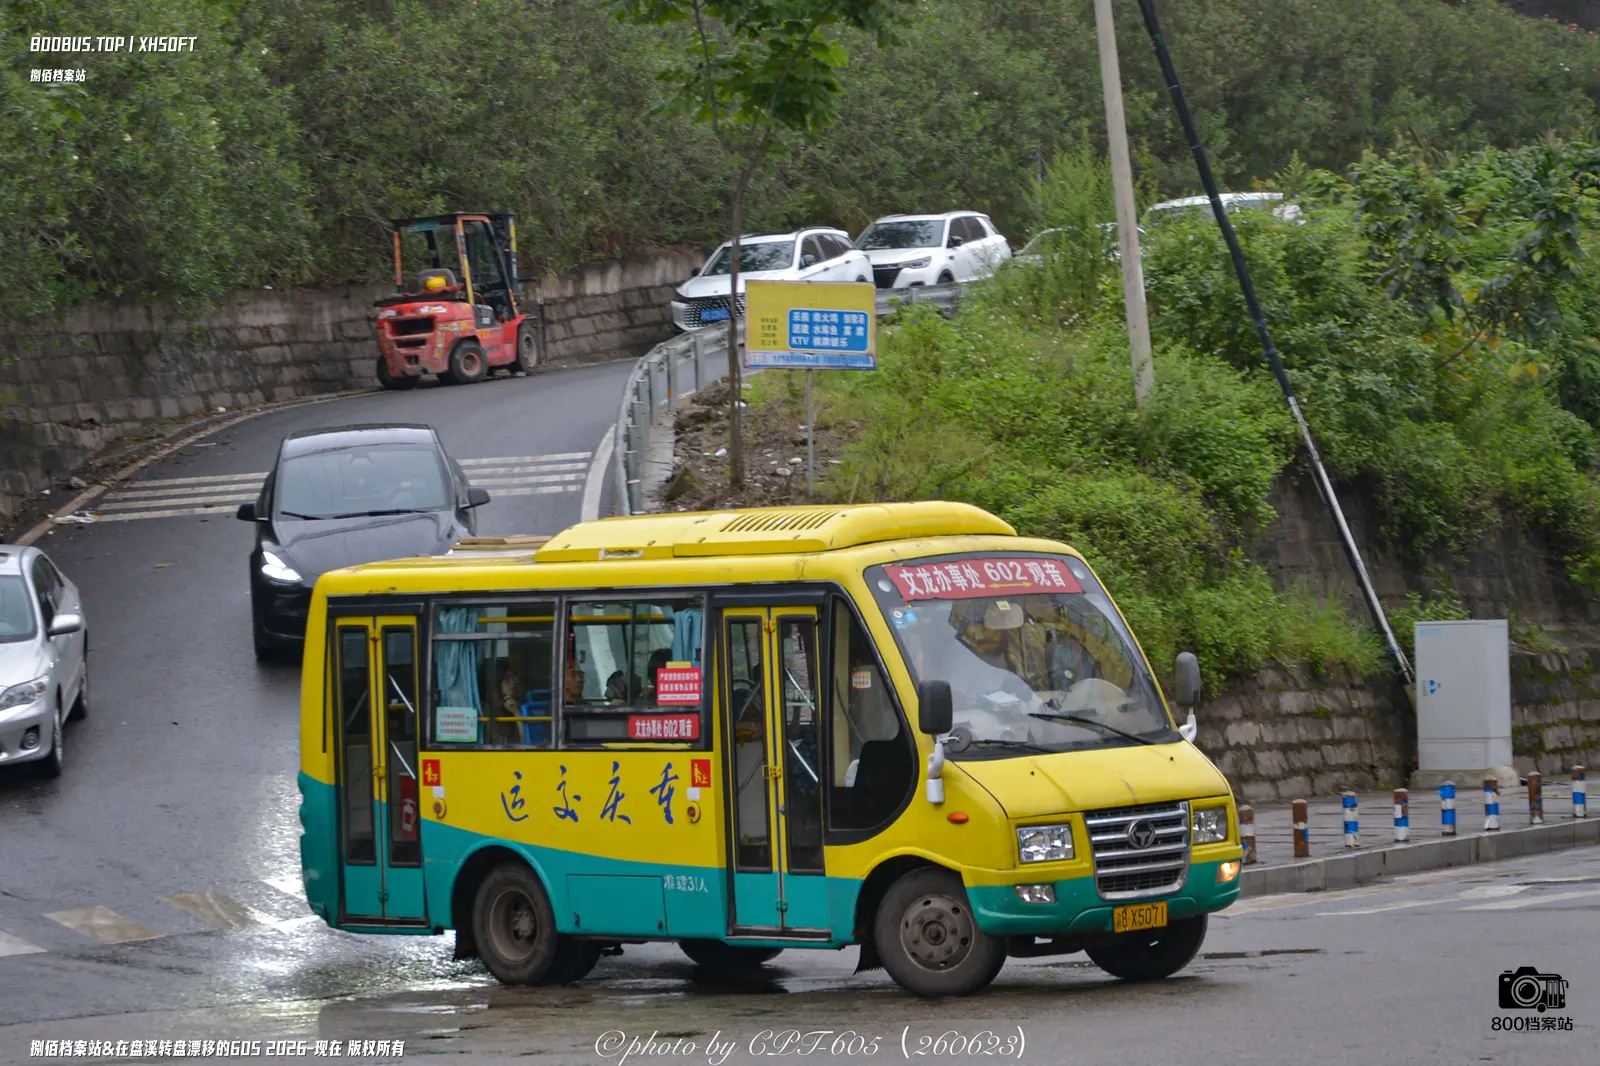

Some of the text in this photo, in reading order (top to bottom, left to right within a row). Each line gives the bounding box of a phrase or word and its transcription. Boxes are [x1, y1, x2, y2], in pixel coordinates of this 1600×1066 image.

[791, 337, 809, 346] KTV
[899, 560, 1066, 596] 文龙办事处 602 观音
[663, 719, 678, 737] 602
